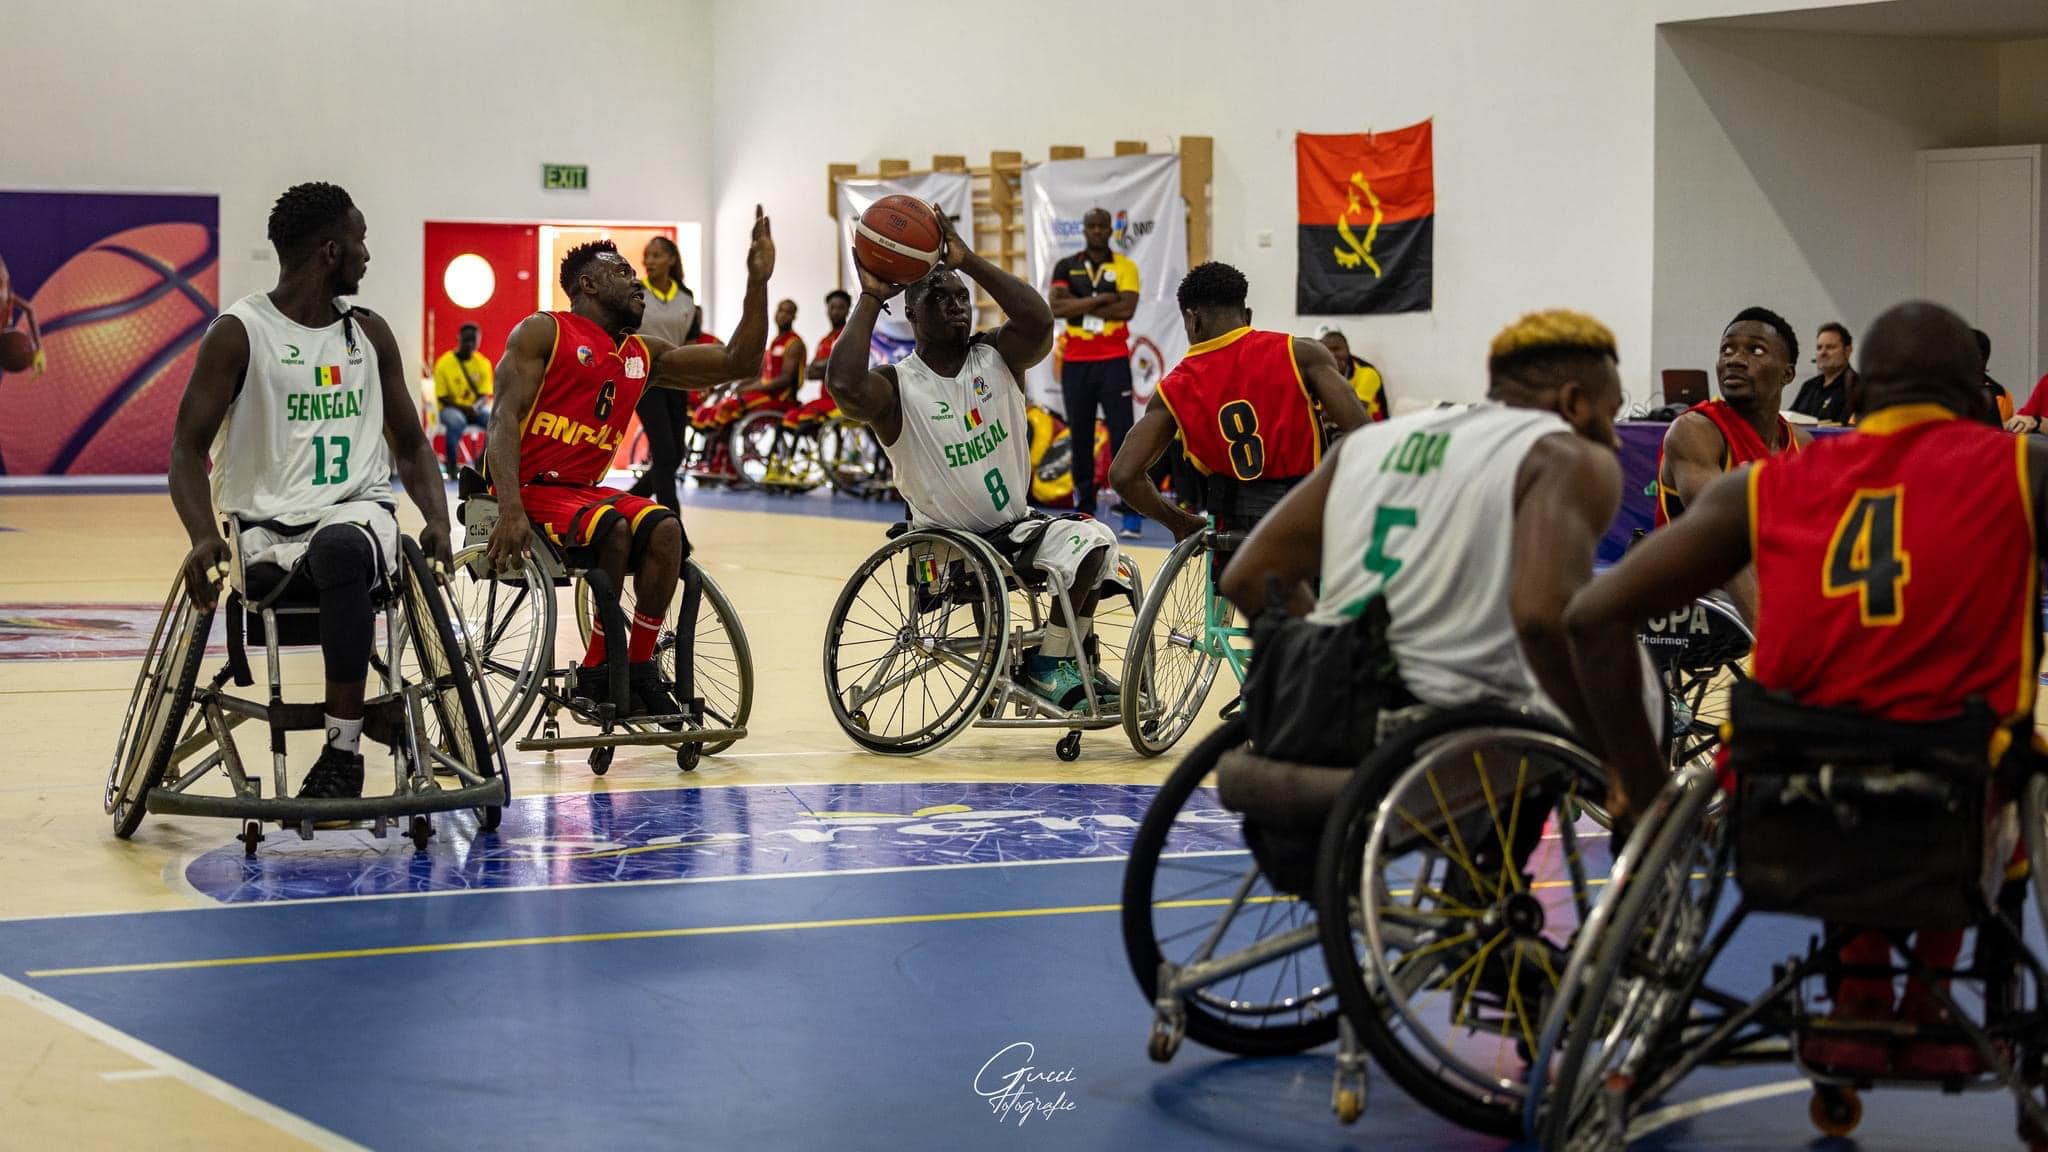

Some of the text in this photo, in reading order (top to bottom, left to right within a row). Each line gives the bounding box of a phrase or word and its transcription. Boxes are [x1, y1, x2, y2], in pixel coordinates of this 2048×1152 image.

[546, 168, 585, 188] EXIT
[594, 380, 616, 422] 6
[311, 435, 350, 486] 13
[944, 418, 1008, 468] SENEGAL
[1218, 399, 1265, 480] 8
[983, 467, 1010, 512] 8
[1338, 505, 1418, 616] 5
[1822, 483, 1911, 628] 4
